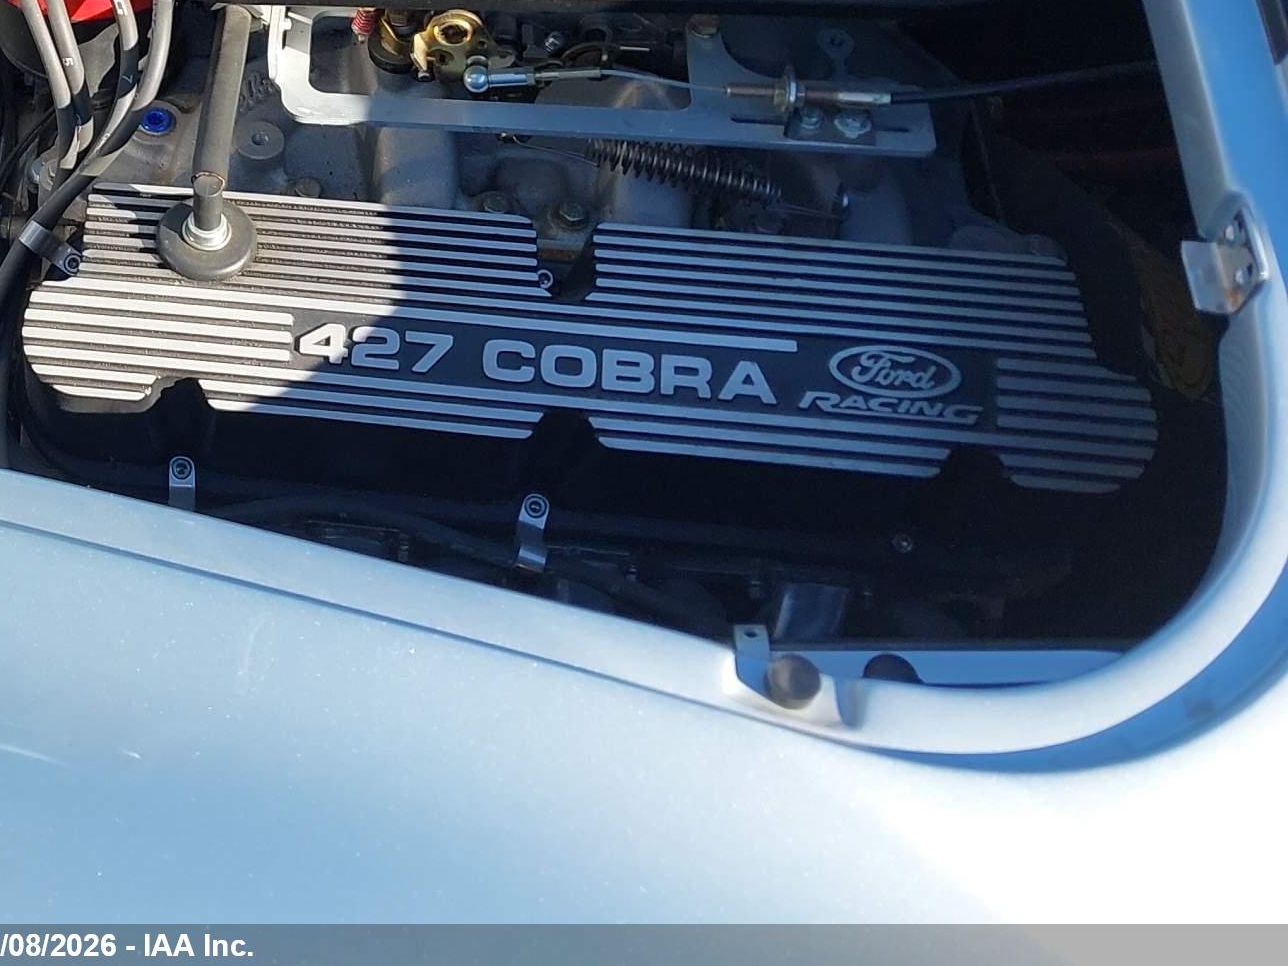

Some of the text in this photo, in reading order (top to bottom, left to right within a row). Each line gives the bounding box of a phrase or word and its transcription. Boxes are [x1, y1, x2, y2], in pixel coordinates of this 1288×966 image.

[299, 323, 778, 405] 427 COBRA
[849, 349, 935, 391] Ford
[799, 390, 984, 424] RACING
